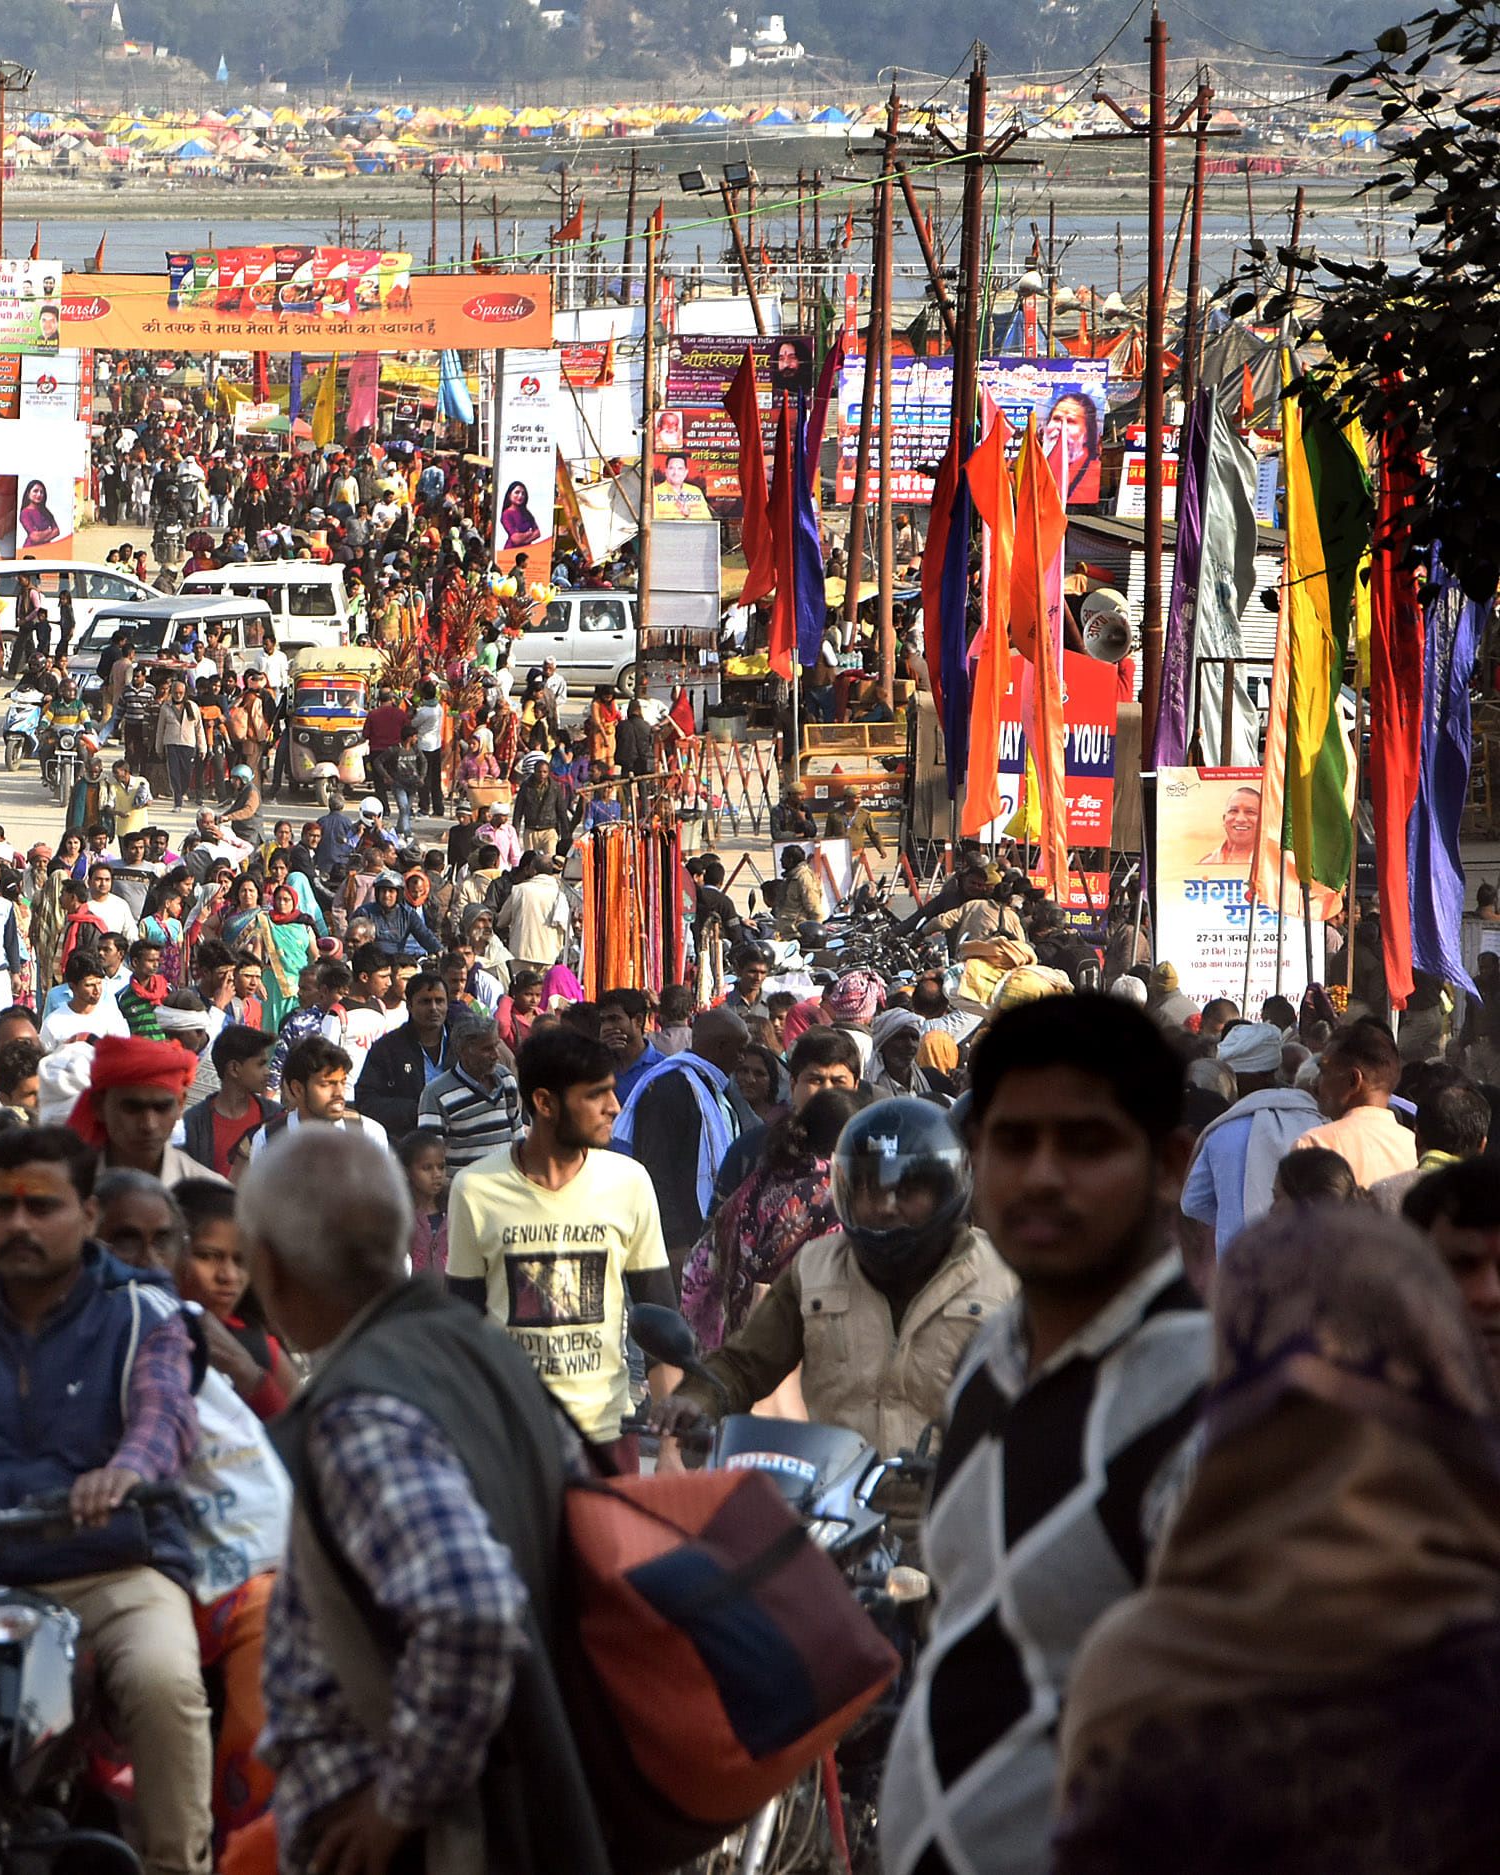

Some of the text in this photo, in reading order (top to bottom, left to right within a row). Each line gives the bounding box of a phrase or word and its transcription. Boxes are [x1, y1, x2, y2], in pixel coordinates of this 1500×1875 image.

[60, 296, 101, 318] parsh
[470, 298, 528, 321] Sparsh
[142, 319, 160, 334] की
[164, 323, 196, 334] तरफ
[199, 319, 212, 334] से
[215, 322, 242, 334] माघ
[245, 320, 274, 334] मेला
[277, 319, 288, 334] में
[294, 324, 321, 335] आप
[325, 320, 353, 335] सभी
[356, 324, 375, 335] का
[379, 323, 424, 335] स्वागत
[691, 448, 740, 461] हार्दिक स्वा
[1184, 875, 1244, 904] गंगा
[1196, 933, 1224, 943] 27-31
[1201, 947, 1210, 956] 27
[1234, 948, 1242, 956] 21
[502, 1223, 607, 1245] GENUINE RIDERS
[547, 1331, 603, 1355] RIDERS
[531, 1352, 601, 1376] THE WIND
[725, 1451, 817, 1482] POLICE
